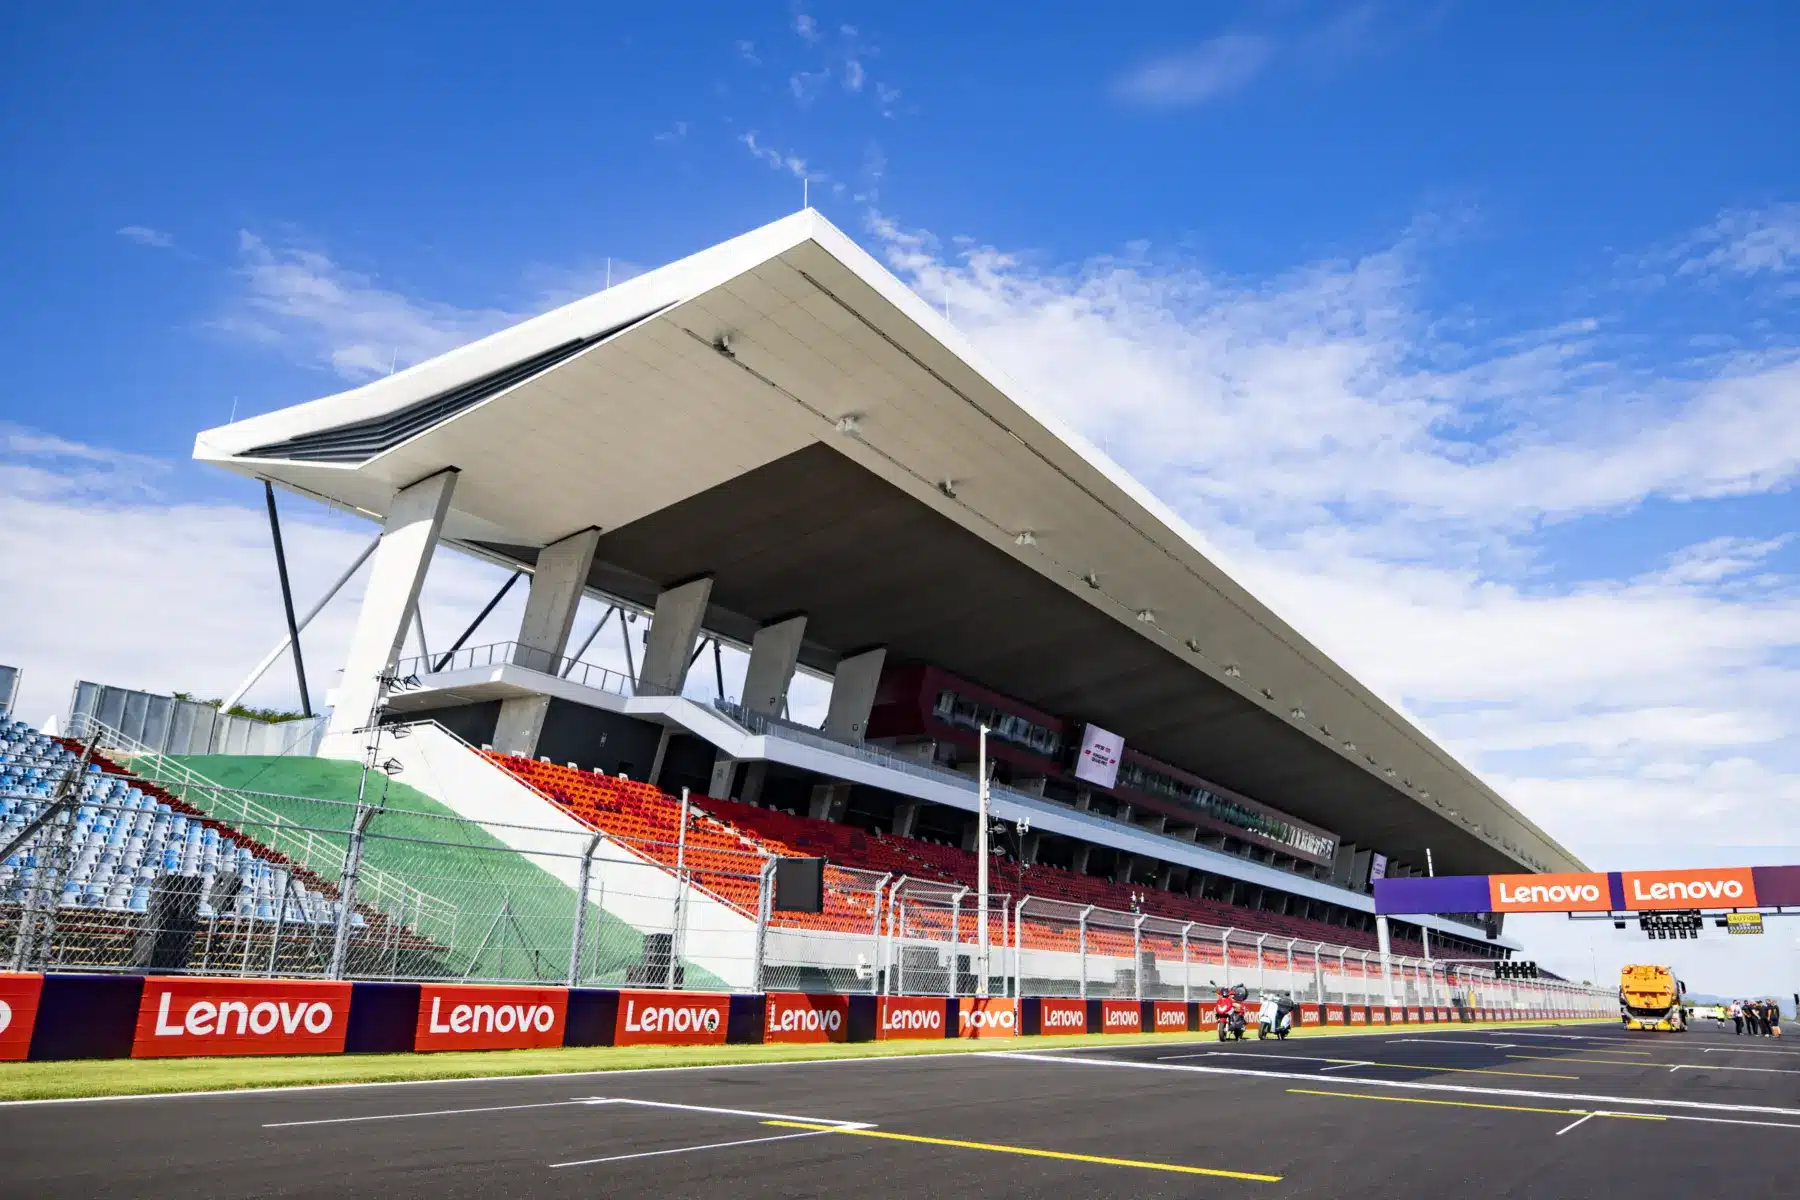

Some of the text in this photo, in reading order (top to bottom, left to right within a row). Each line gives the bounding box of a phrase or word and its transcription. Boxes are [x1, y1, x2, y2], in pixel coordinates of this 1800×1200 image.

[1499, 882, 1600, 903] Lenovo
[1633, 879, 1743, 901] Lenovo
[154, 991, 333, 1036] Lenovo
[429, 996, 555, 1034] Lenovo
[625, 1000, 720, 1032] Lenovo
[769, 1003, 841, 1032] Lenovo
[882, 1004, 940, 1029] Lenovo
[1044, 1006, 1083, 1027] Lenovo
[1105, 1007, 1138, 1026] Lenovo
[1156, 1008, 1185, 1026] Lenovo
[1200, 1007, 1216, 1024] Len
